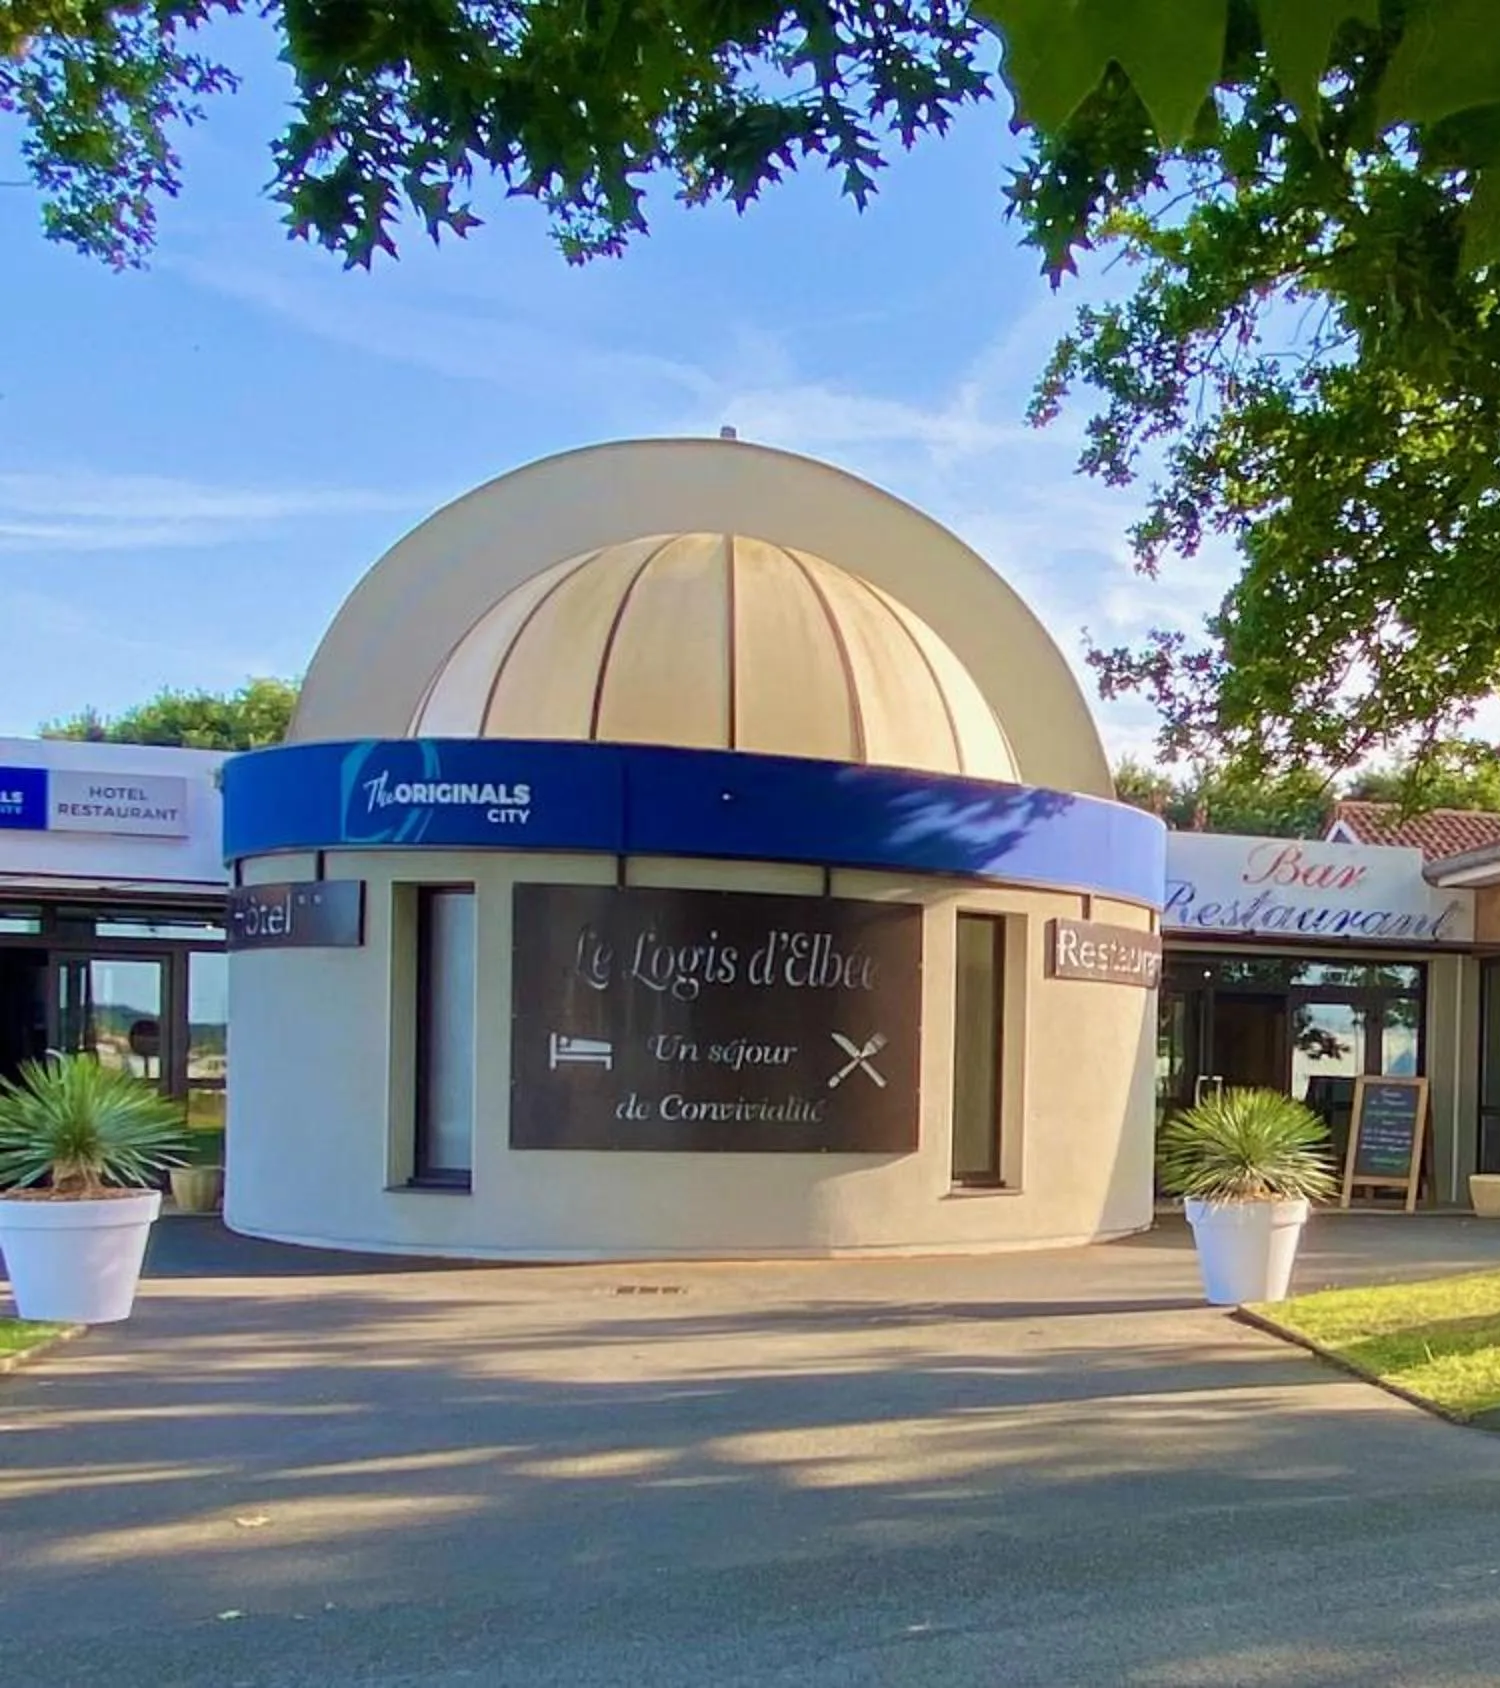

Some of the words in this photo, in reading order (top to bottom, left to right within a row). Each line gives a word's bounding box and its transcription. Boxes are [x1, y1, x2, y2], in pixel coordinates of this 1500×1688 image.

[0, 790, 24, 804] LS
[89, 786, 148, 800] HOTEL
[362, 769, 395, 813] The
[395, 783, 532, 806] ORIGINALS
[57, 803, 179, 821] RESTAURANT
[487, 808, 531, 825] CITY
[1242, 841, 1367, 890] Bar
[1163, 879, 1461, 941] Restaurant
[576, 923, 613, 991] Le
[621, 929, 738, 1001] Logis
[648, 1034, 699, 1062] Un
[707, 1036, 799, 1071] séjour
[615, 1091, 650, 1121] de
